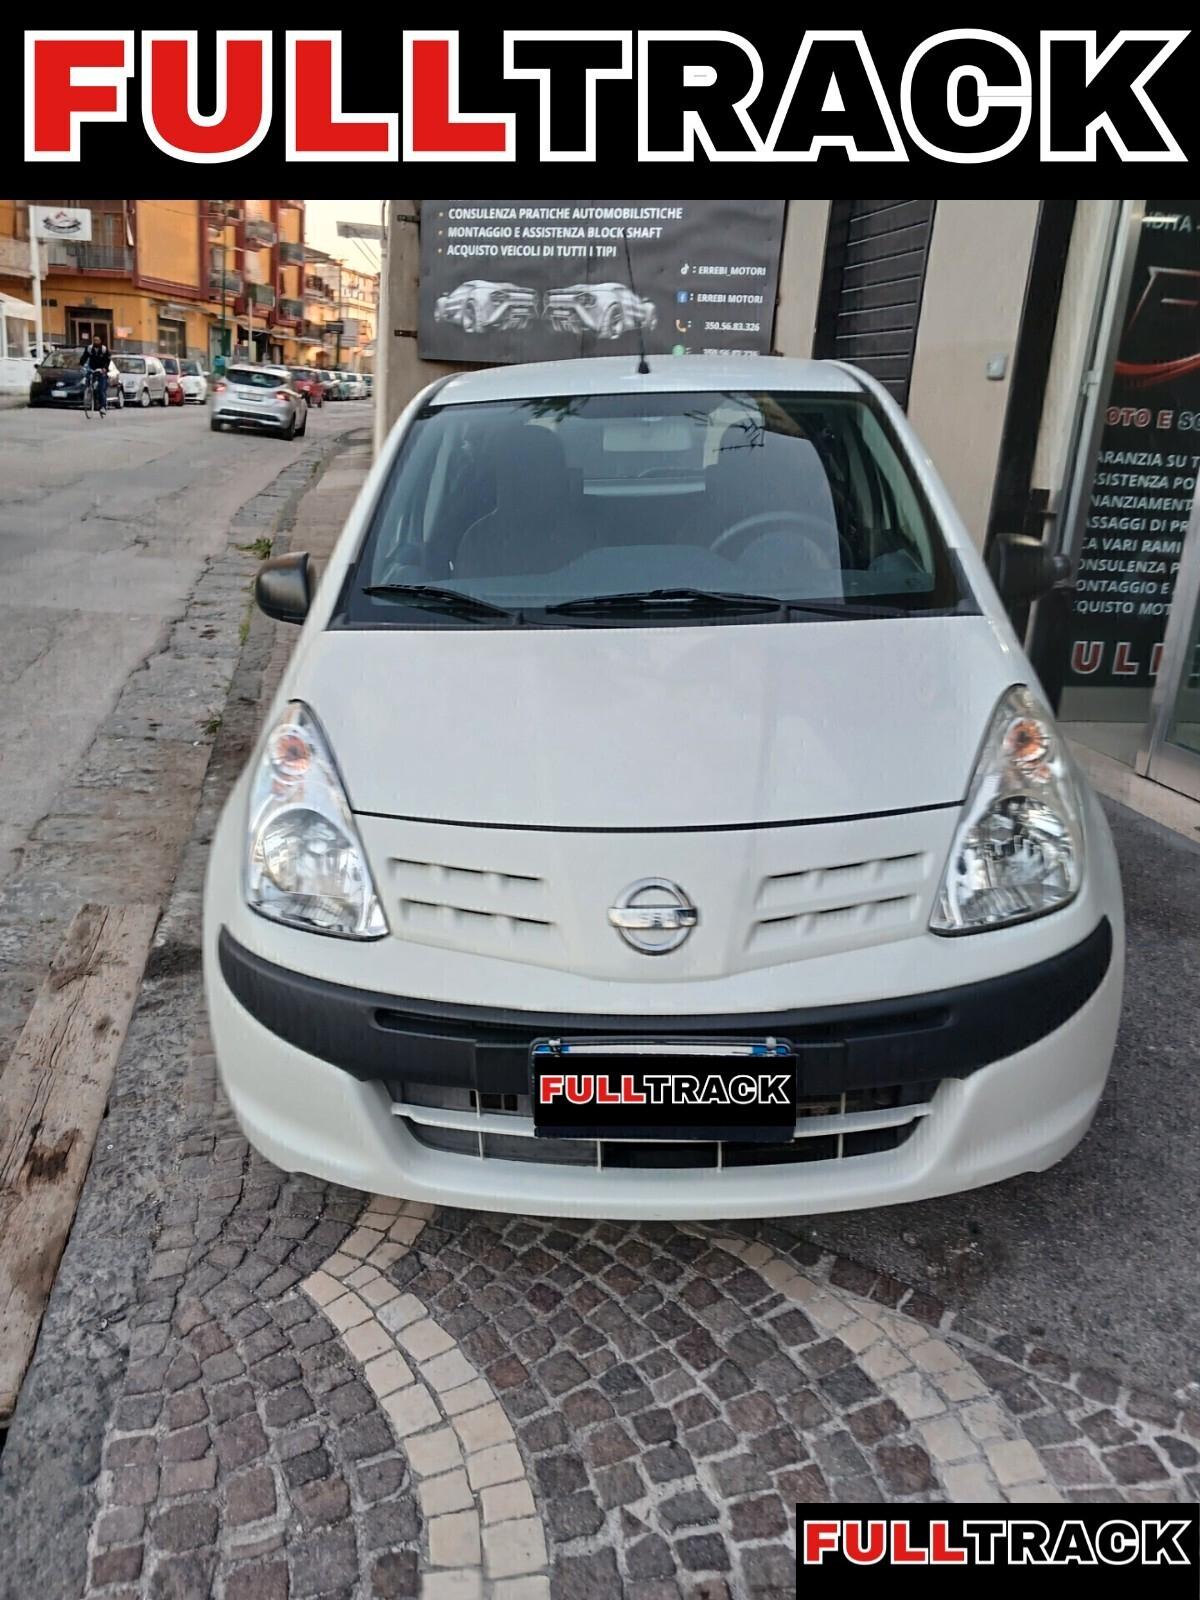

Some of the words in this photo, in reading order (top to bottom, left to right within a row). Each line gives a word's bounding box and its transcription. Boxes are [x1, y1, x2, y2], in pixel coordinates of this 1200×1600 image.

[448, 208, 517, 220] CONSULENZA
[518, 208, 570, 220] PRATICHE
[572, 207, 683, 220] AUTOMOBILISTICHE
[447, 226, 512, 238] MONTAGGIO
[514, 227, 520, 238] E
[522, 227, 585, 239] ASSISTENZA
[587, 227, 624, 238] BLOCK
[626, 227, 663, 239] SHAFT
[446, 244, 499, 258] ACQUISTO
[500, 245, 541, 256] VEICOLI
[542, 246, 554, 256] DI
[557, 245, 587, 257] TUTTI
[589, 246, 593, 257] I
[596, 245, 617, 257] TIPI
[697, 293, 726, 303] ERREBI
[727, 294, 764, 304] MOTORI
[1155, 409, 1174, 429] E
[1166, 454, 1187, 468] SU
[1094, 472, 1170, 489] SISTENZA
[1172, 476, 1195, 490] PO
[1149, 518, 1167, 532] DI
[1102, 538, 1138, 552] VARI
[1141, 540, 1182, 554] RAMI
[1076, 580, 1157, 594] ONTAGGIO
[1160, 582, 1171, 594] E
[1073, 601, 1134, 615] QUISTO
